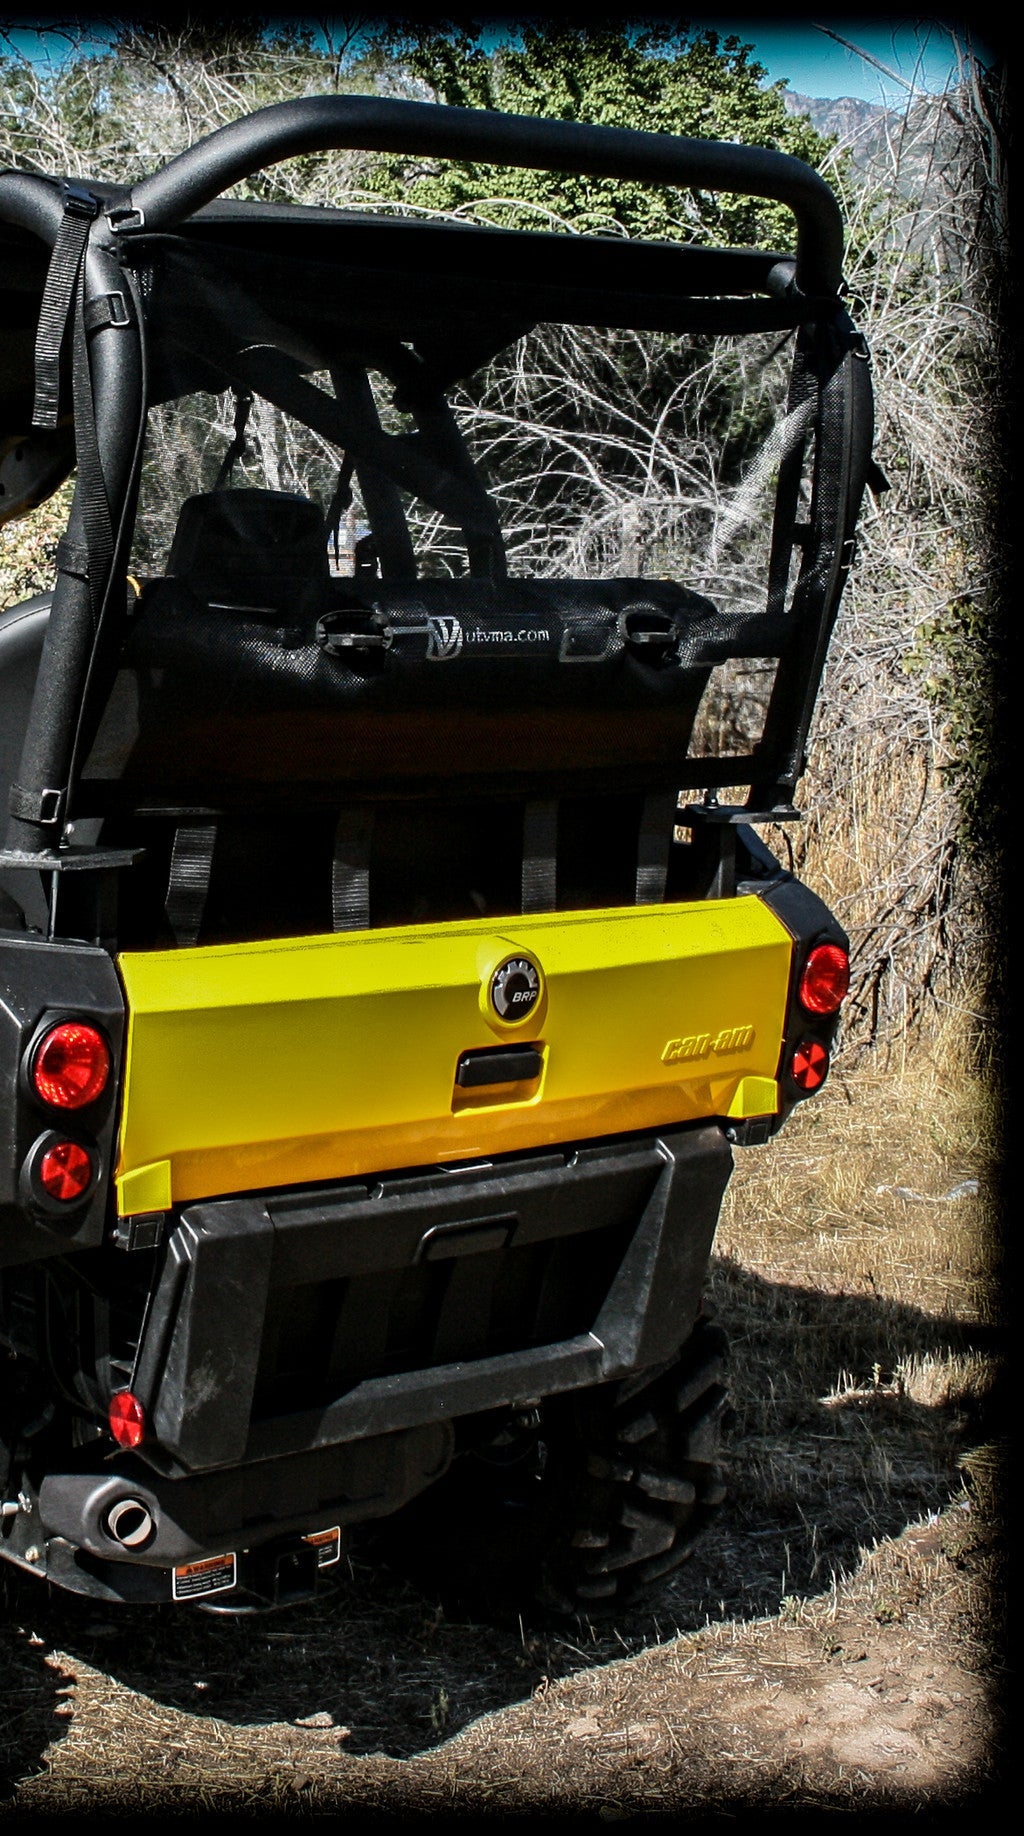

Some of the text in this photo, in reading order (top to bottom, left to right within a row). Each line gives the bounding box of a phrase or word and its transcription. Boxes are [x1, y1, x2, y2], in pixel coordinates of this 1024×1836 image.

[465, 627, 550, 643] utvma.com
[512, 991, 538, 1003] BRP
[661, 1025, 756, 1062] can-am
